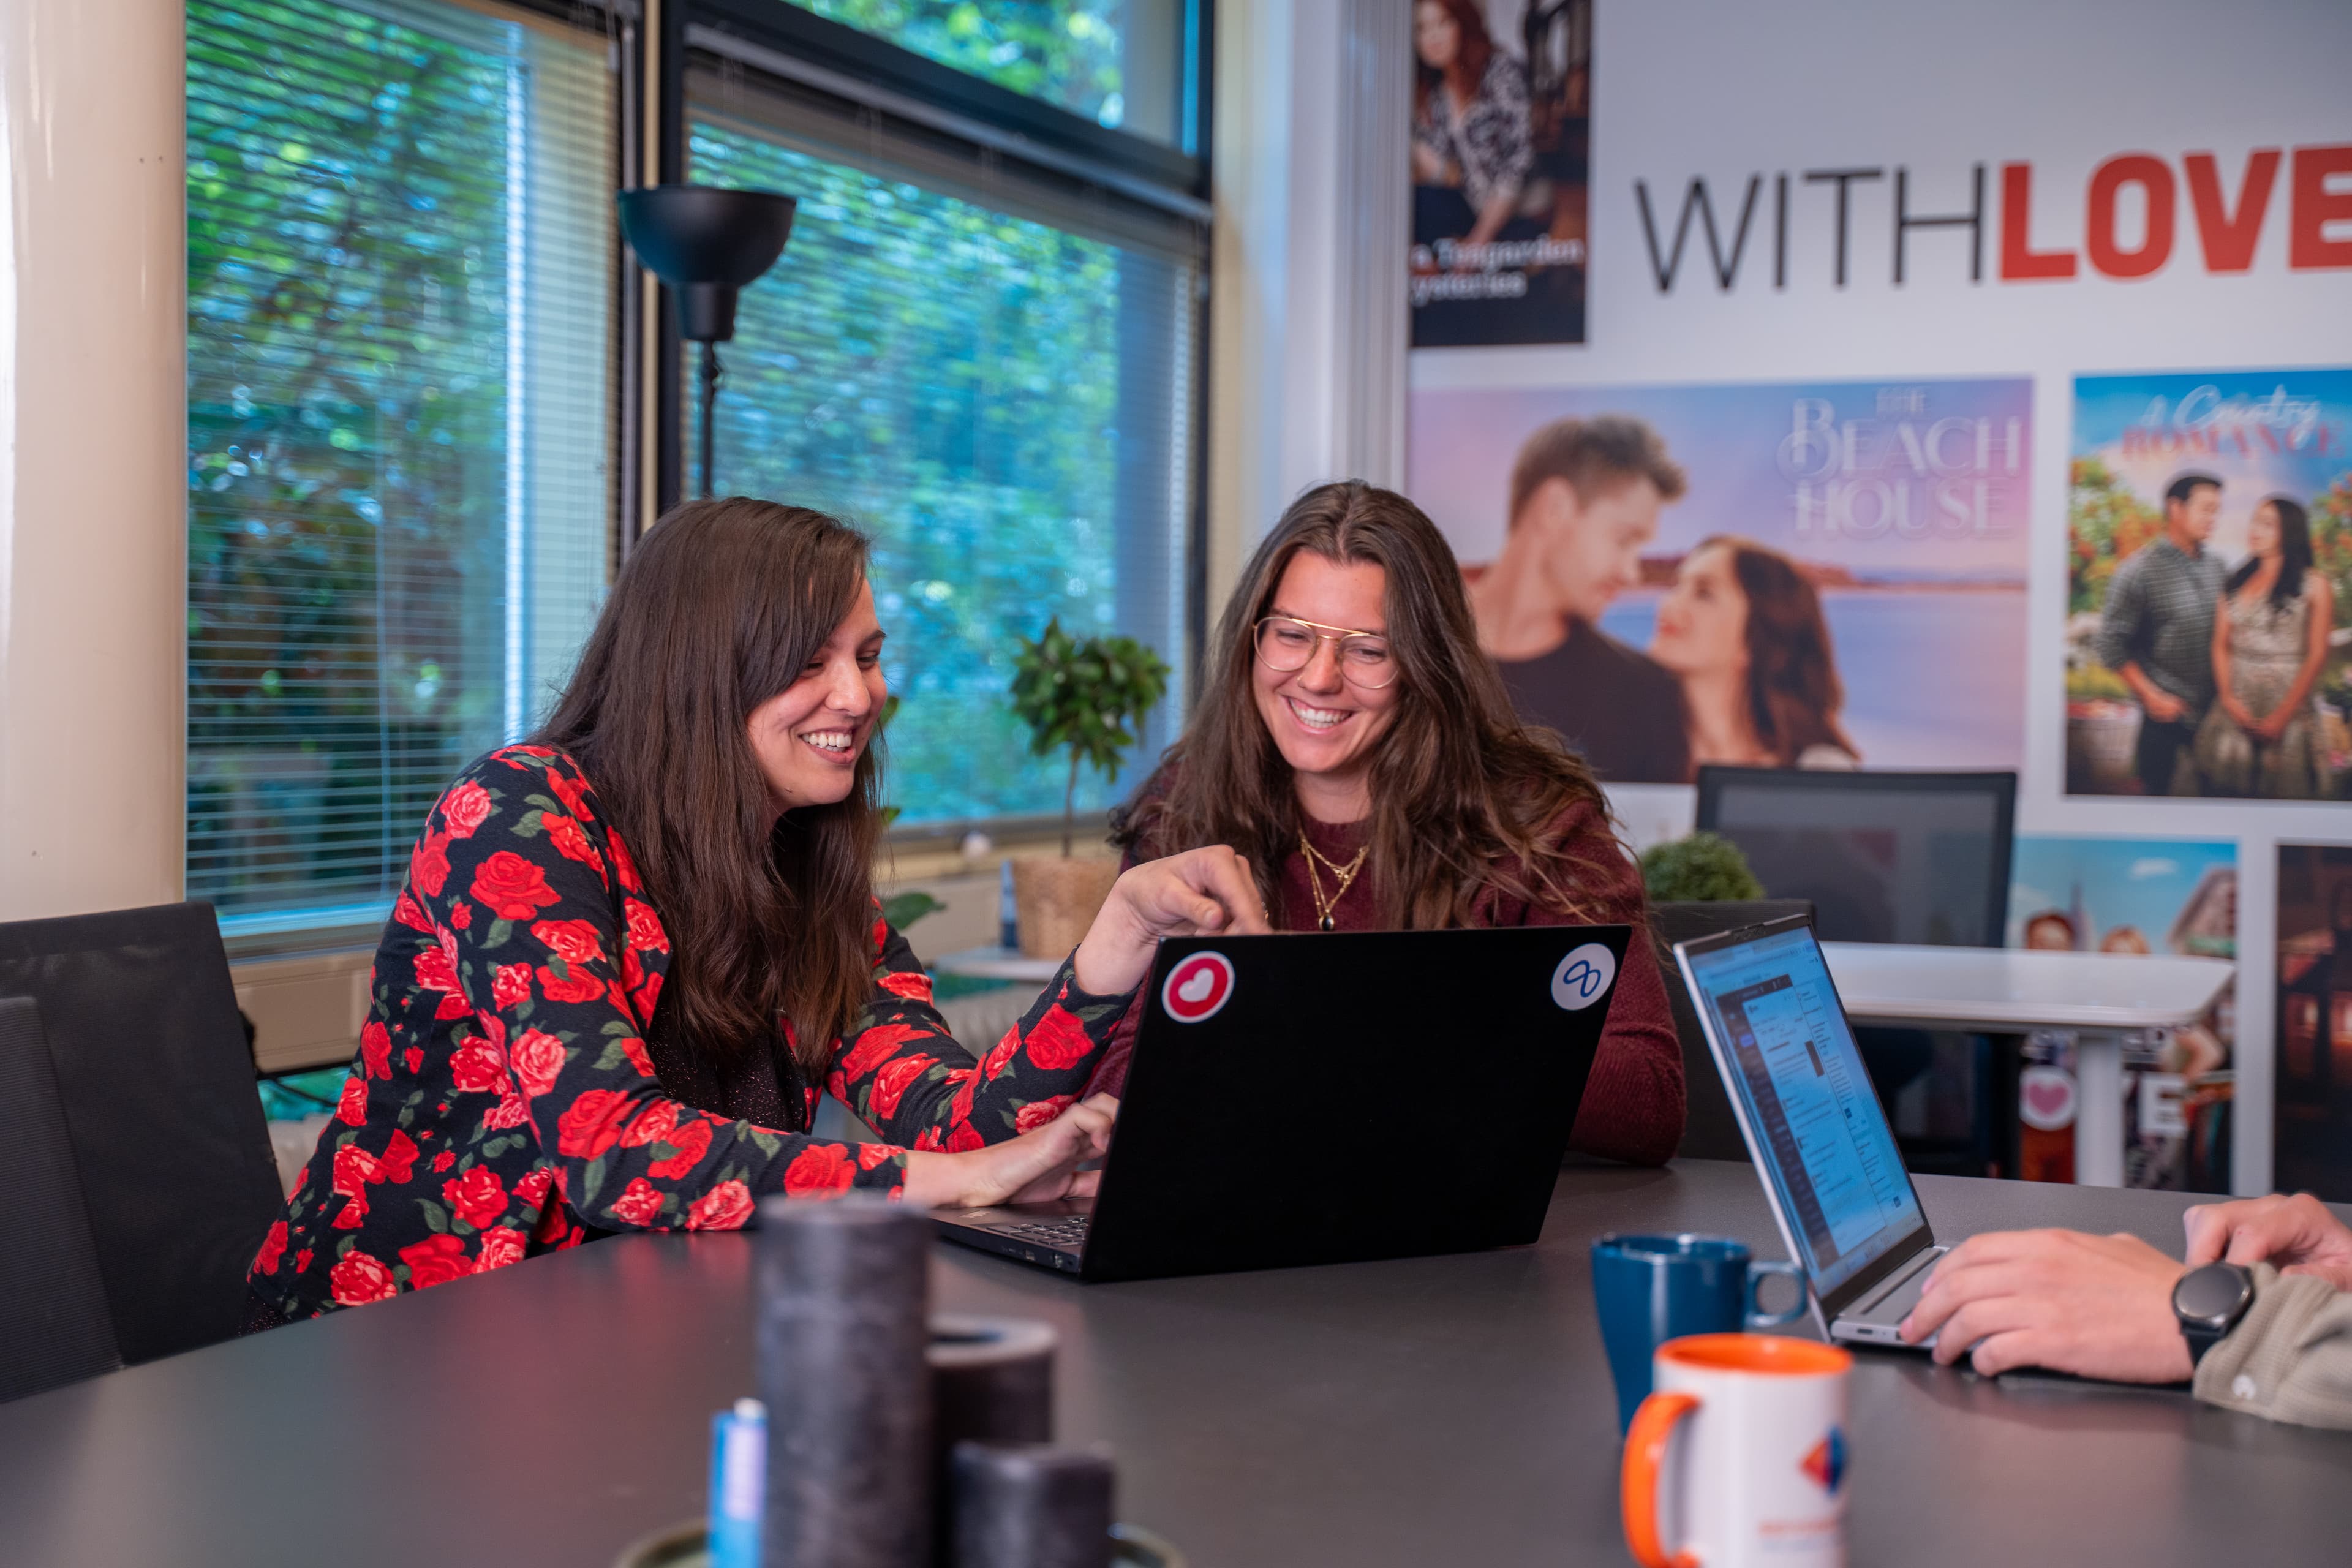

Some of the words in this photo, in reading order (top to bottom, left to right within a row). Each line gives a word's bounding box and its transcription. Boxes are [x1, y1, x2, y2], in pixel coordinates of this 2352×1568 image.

[1410, 272, 1528, 307] ysteries
[1777, 397, 2021, 484] BEACH
[1789, 477, 2015, 538] HOUSE
